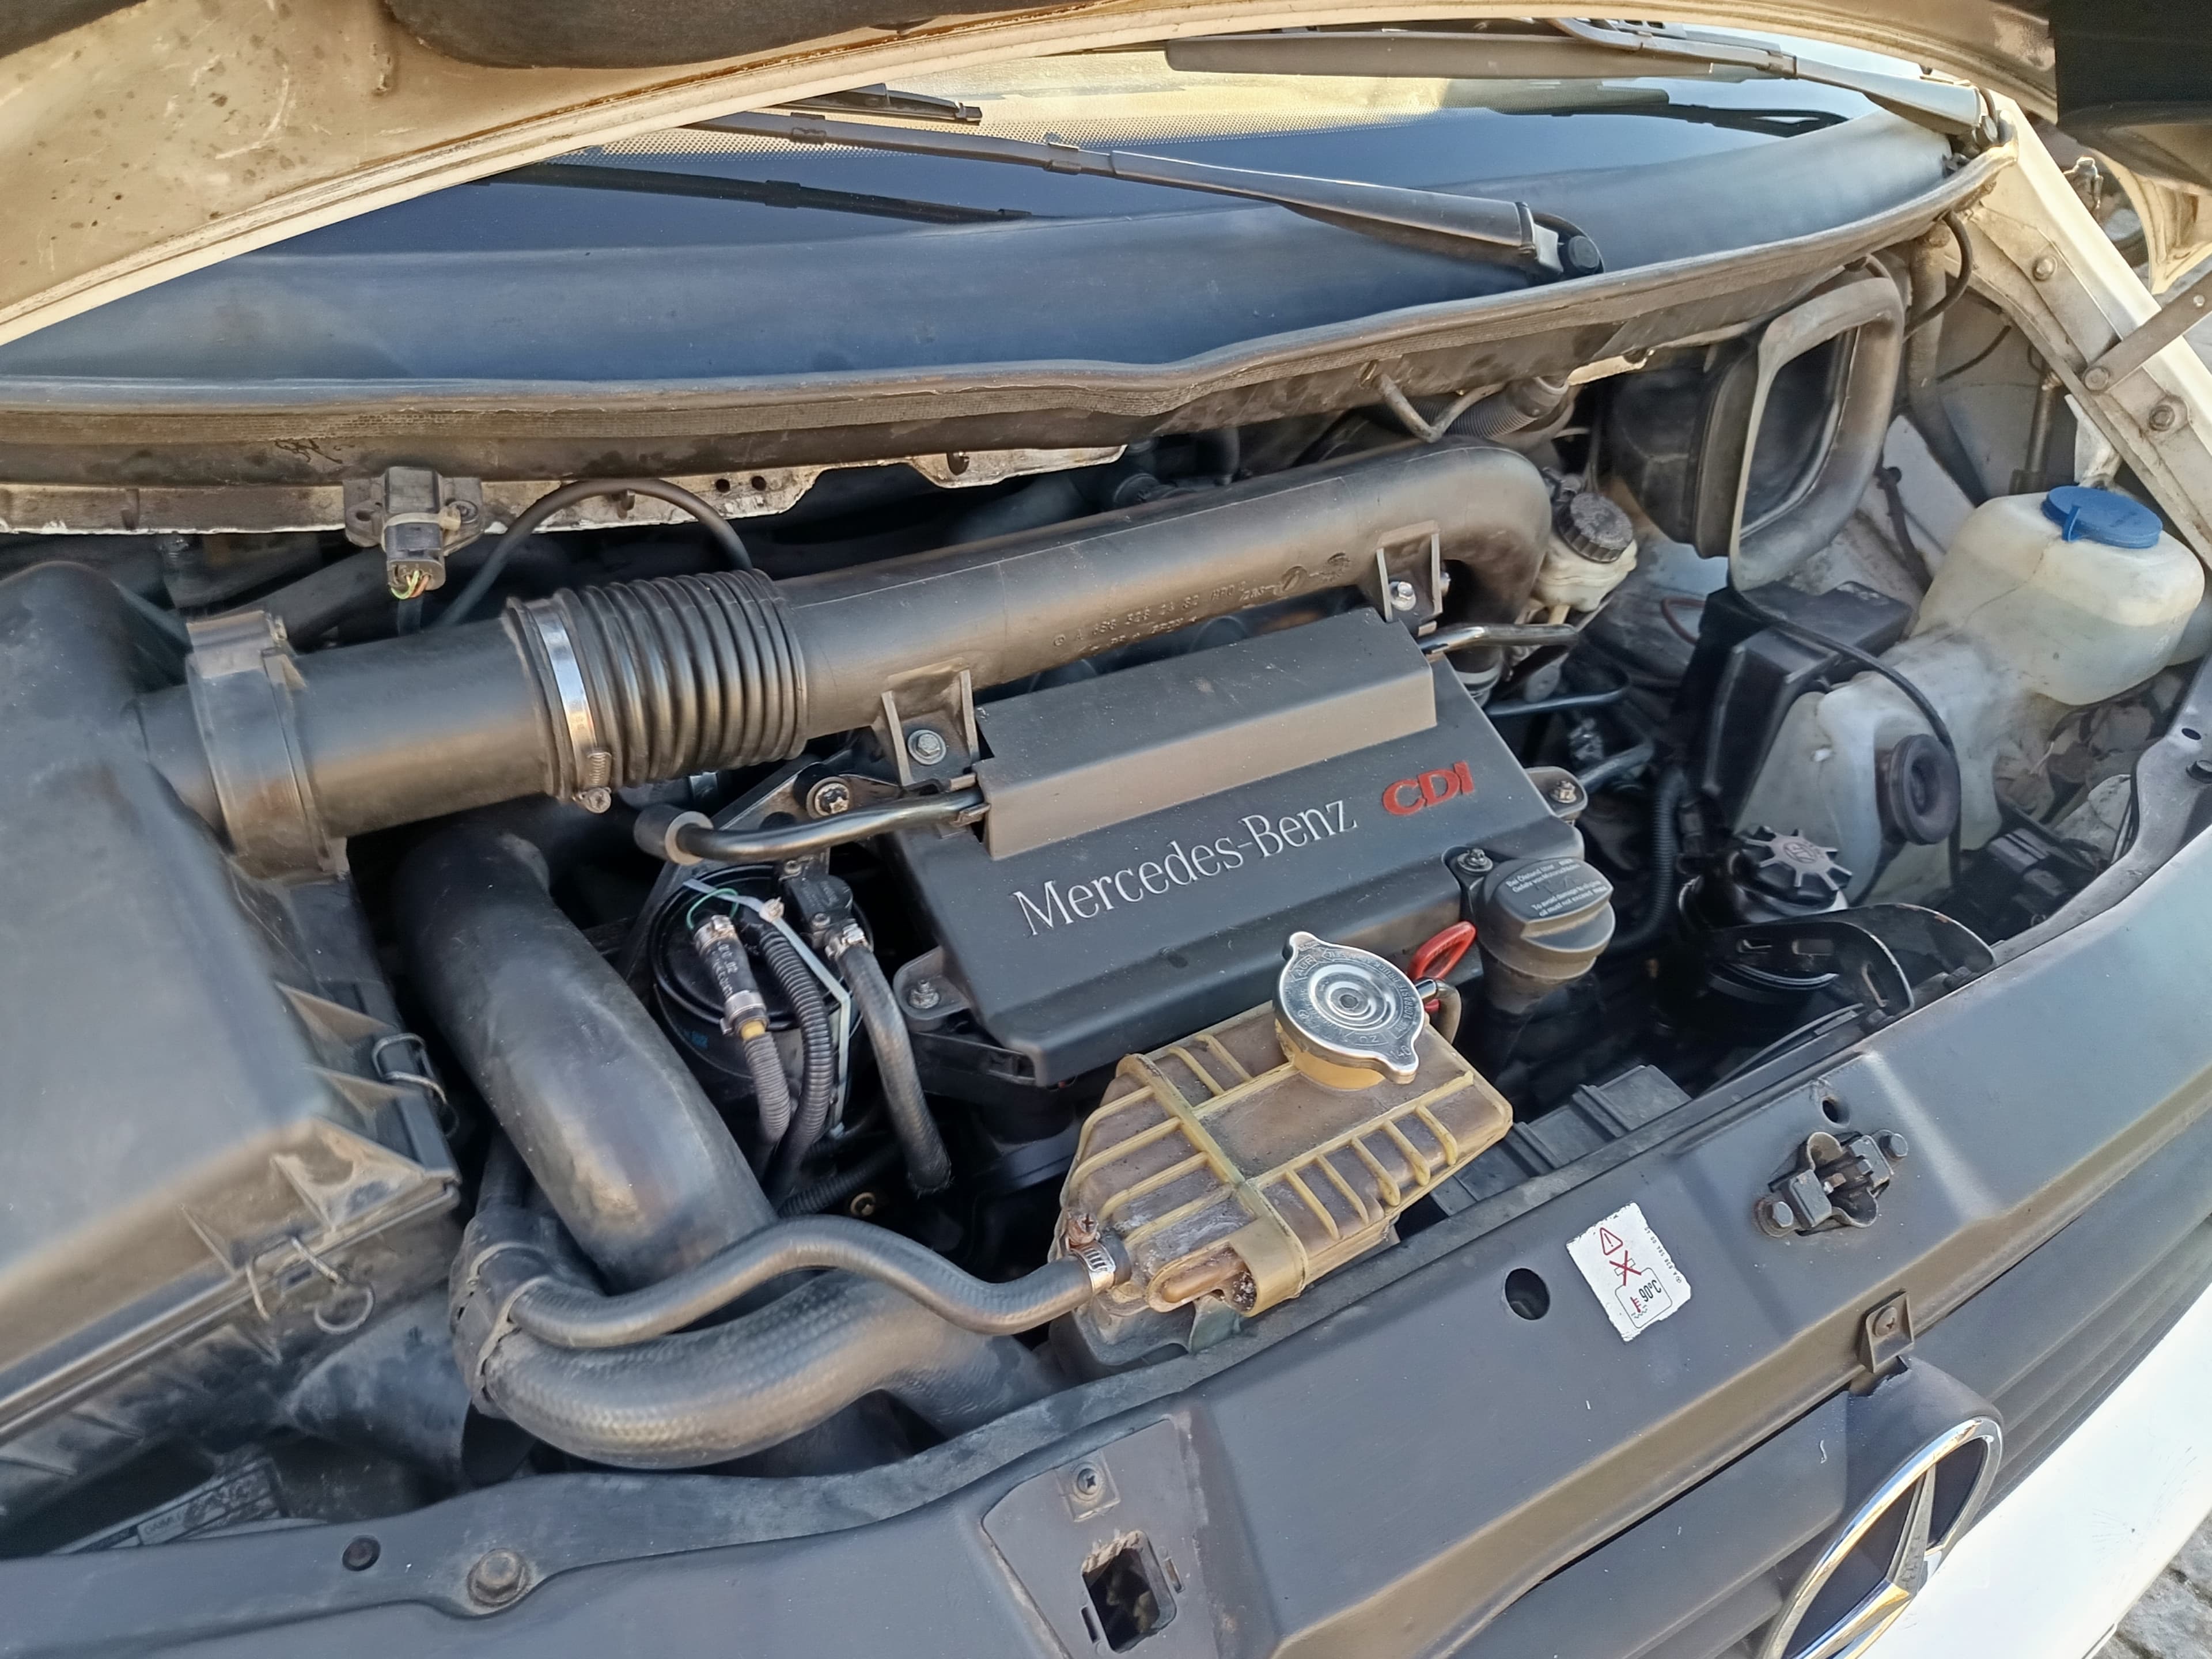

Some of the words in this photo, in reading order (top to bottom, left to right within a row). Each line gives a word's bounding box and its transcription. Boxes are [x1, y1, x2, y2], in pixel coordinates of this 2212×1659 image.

[1382, 761, 1475, 816] CDI
[1013, 800, 1358, 937] Mercedes-Benz
[1296, 957, 1316, 976] AUF
[1359, 1035, 1379, 1043] ZU
[1638, 1279, 1662, 1302] 90°C
